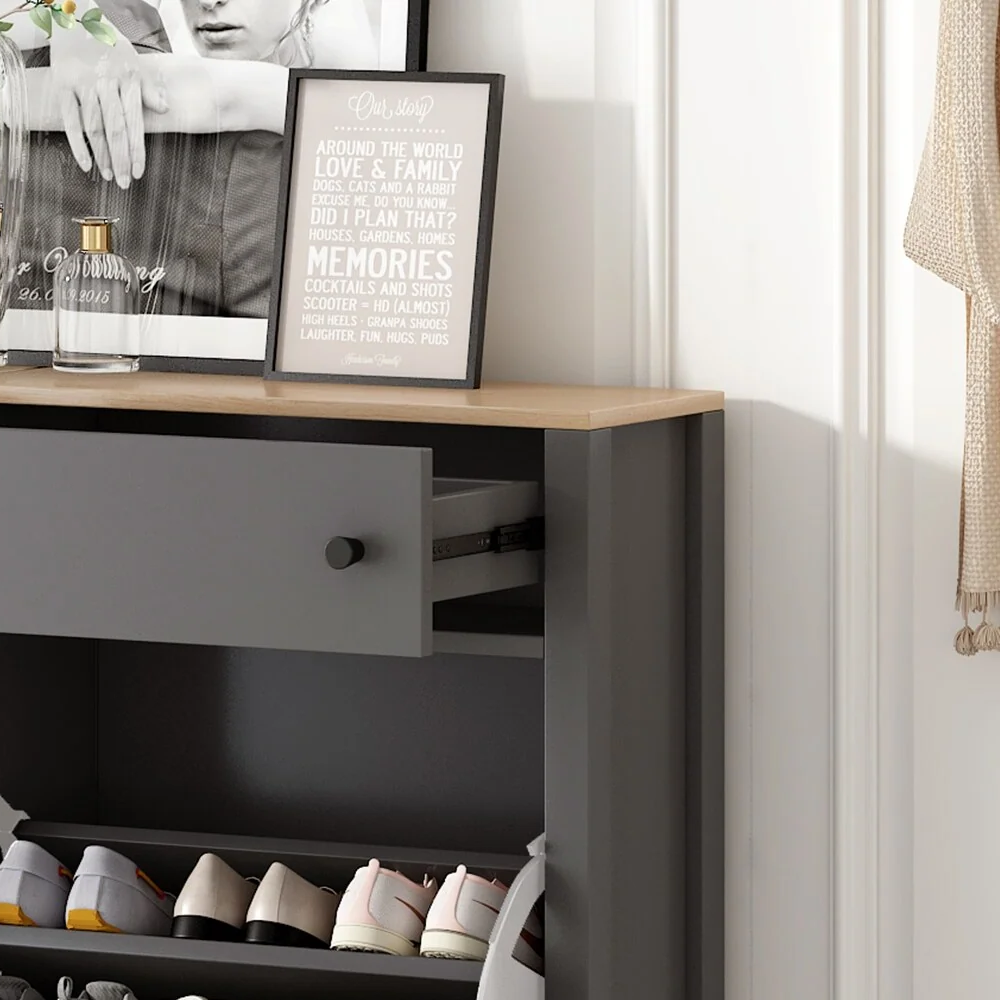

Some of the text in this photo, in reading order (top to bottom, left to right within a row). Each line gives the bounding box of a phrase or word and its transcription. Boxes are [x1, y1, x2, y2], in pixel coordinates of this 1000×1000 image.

[348, 91, 433, 124] Our story
[316, 140, 463, 159] AROUND THE WORLD
[315, 157, 462, 181] LOVE & FAMILY
[349, 181, 376, 192] CATS
[381, 182, 402, 193] AND
[406, 183, 413, 194] A
[418, 183, 456, 195] RABBIT
[312, 194, 350, 206] EXCUSE
[375, 196, 388, 207] DO
[393, 196, 413, 208] YOU
[311, 208, 456, 229] DID I PLAN THAT?
[418, 233, 456, 245] HOMES
[307, 246, 453, 280] MEMORIES
[305, 279, 452, 298] COCKTAILS AND SHOTS
[304, 297, 357, 311] SCOOTER
[374, 300, 389, 312] HD
[394, 300, 450, 317] (ALMOST)
[302, 314, 324, 325] HIGH
[327, 315, 357, 326] HEELS
[410, 319, 448, 330] SHOOES
[421, 334, 449, 345] PUDS
